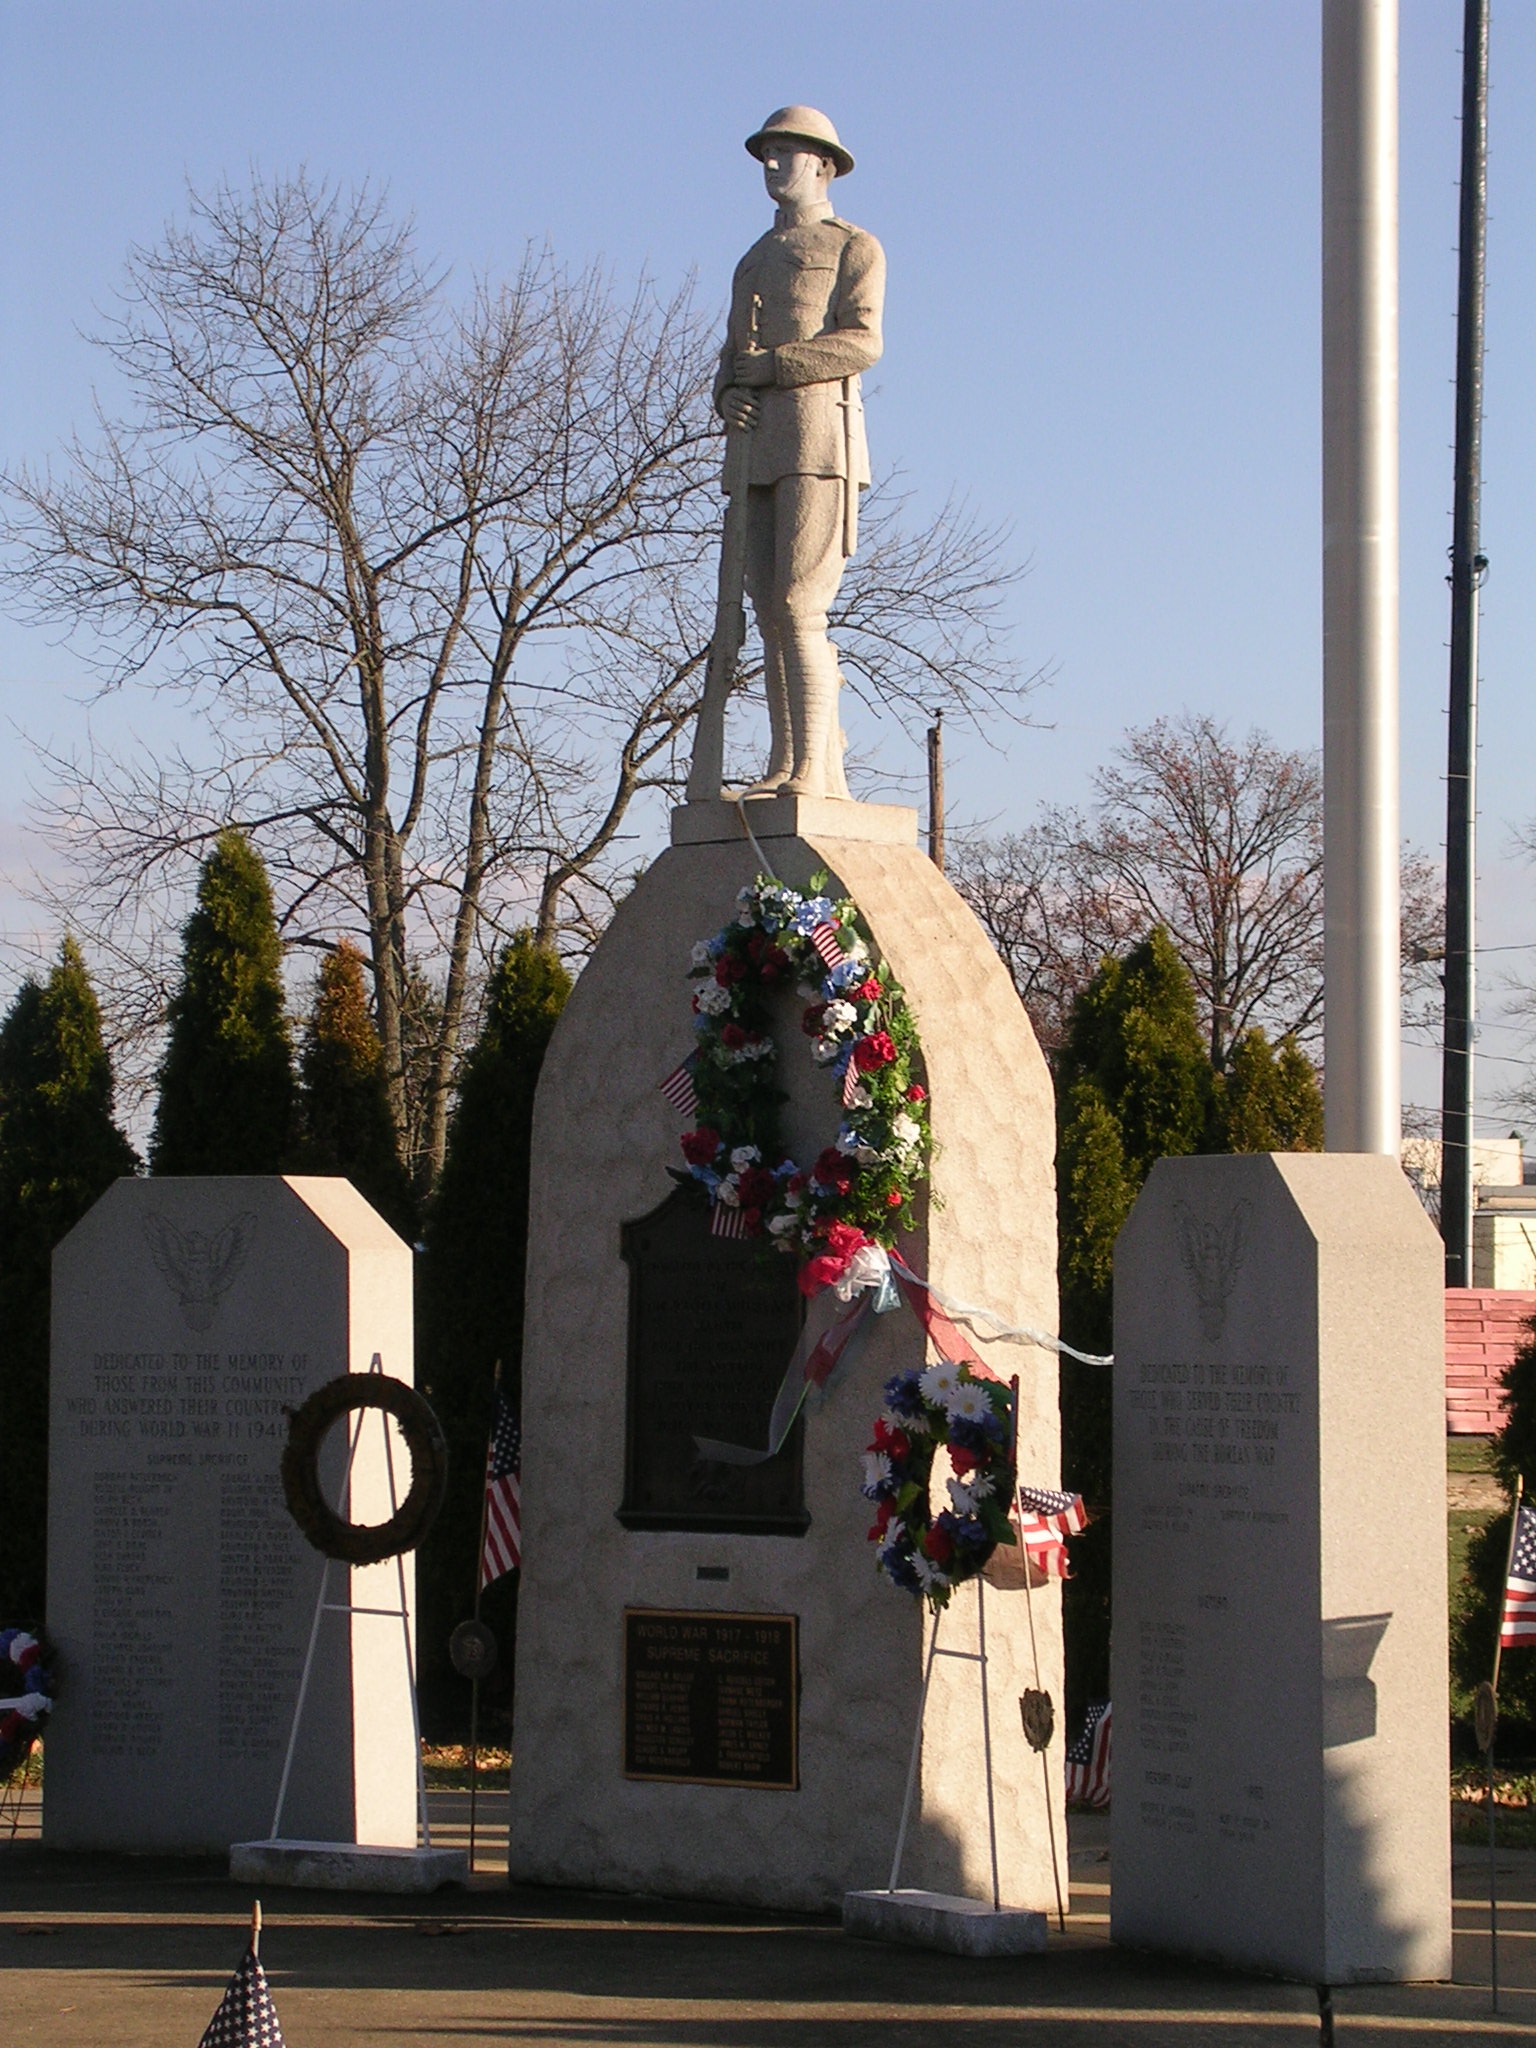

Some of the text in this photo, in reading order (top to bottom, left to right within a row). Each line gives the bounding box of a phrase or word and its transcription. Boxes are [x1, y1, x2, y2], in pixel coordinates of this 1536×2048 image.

[93, 1353, 309, 1372] DEDICATED TO THE MEMORY OF
[94, 1375, 306, 1395] THOSE FROM THIS COMMUNITY
[66, 1397, 97, 1415] WHO
[104, 1397, 172, 1416] ANSWERED
[179, 1398, 218, 1416] THEIR
[80, 1420, 131, 1437] DURING
[139, 1420, 185, 1438] WORLD
[193, 1420, 220, 1438] WAR
[637, 1624, 678, 1640] WORLD
[681, 1626, 708, 1641] WAR
[715, 1627, 741, 1642] 1917
[755, 1629, 781, 1645] 1918
[646, 1646, 770, 1665] SUPREME SACRIFICE
